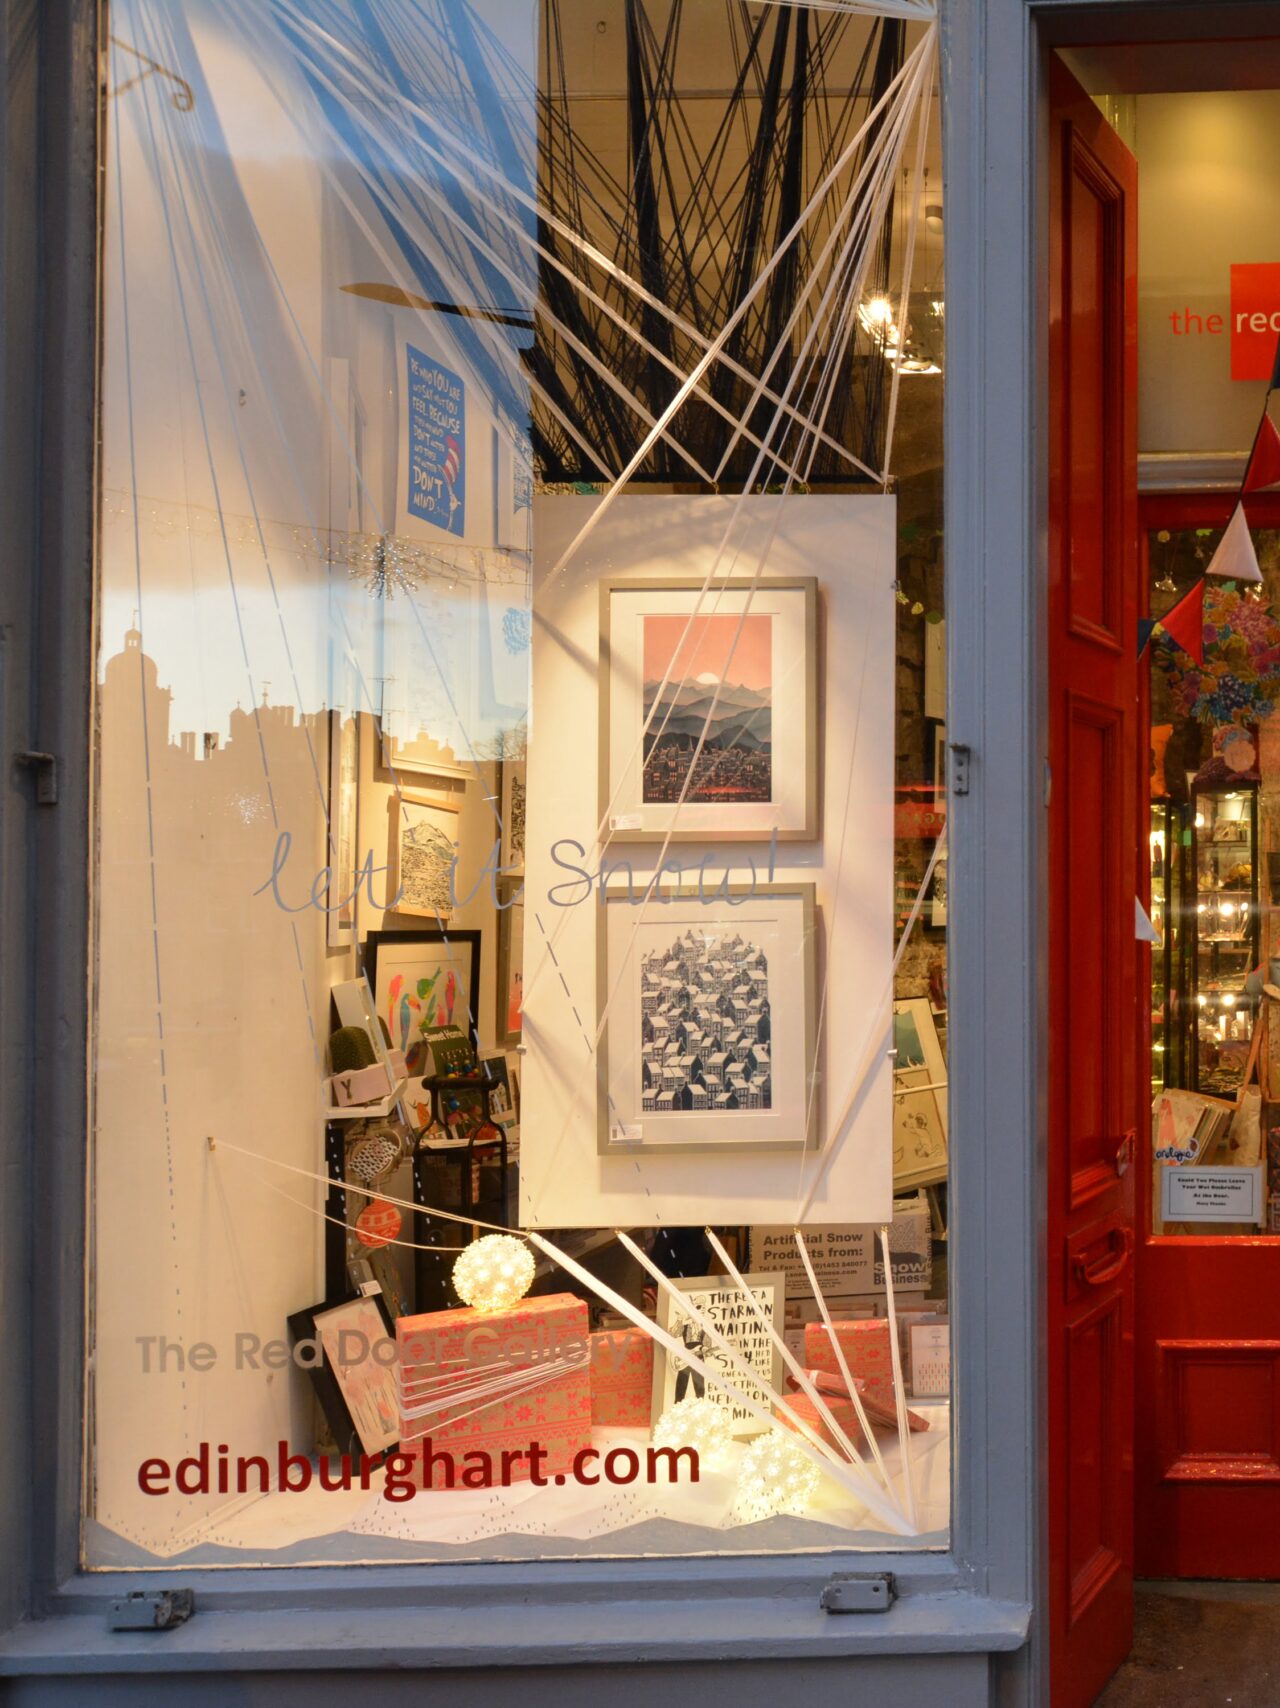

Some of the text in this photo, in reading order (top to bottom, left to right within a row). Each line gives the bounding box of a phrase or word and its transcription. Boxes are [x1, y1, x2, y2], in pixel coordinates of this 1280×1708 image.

[1168, 307, 1223, 335] the
[432, 369, 449, 392] YOU
[413, 464, 443, 499] DON'T
[254, 831, 400, 913] let
[448, 841, 524, 909] it
[764, 1232, 863, 1245] Artifial Snow
[764, 1247, 863, 1260] Produts from:
[873, 1273, 928, 1285] Buiness
[709, 1290, 766, 1305] THERES A
[708, 1304, 772, 1320] STARMN
[714, 1319, 772, 1336] WAITIN
[135, 1326, 633, 1373] The Red Door Gallery
[753, 1338, 770, 1349] THE
[137, 1436, 701, 1502] edinburghart.com
